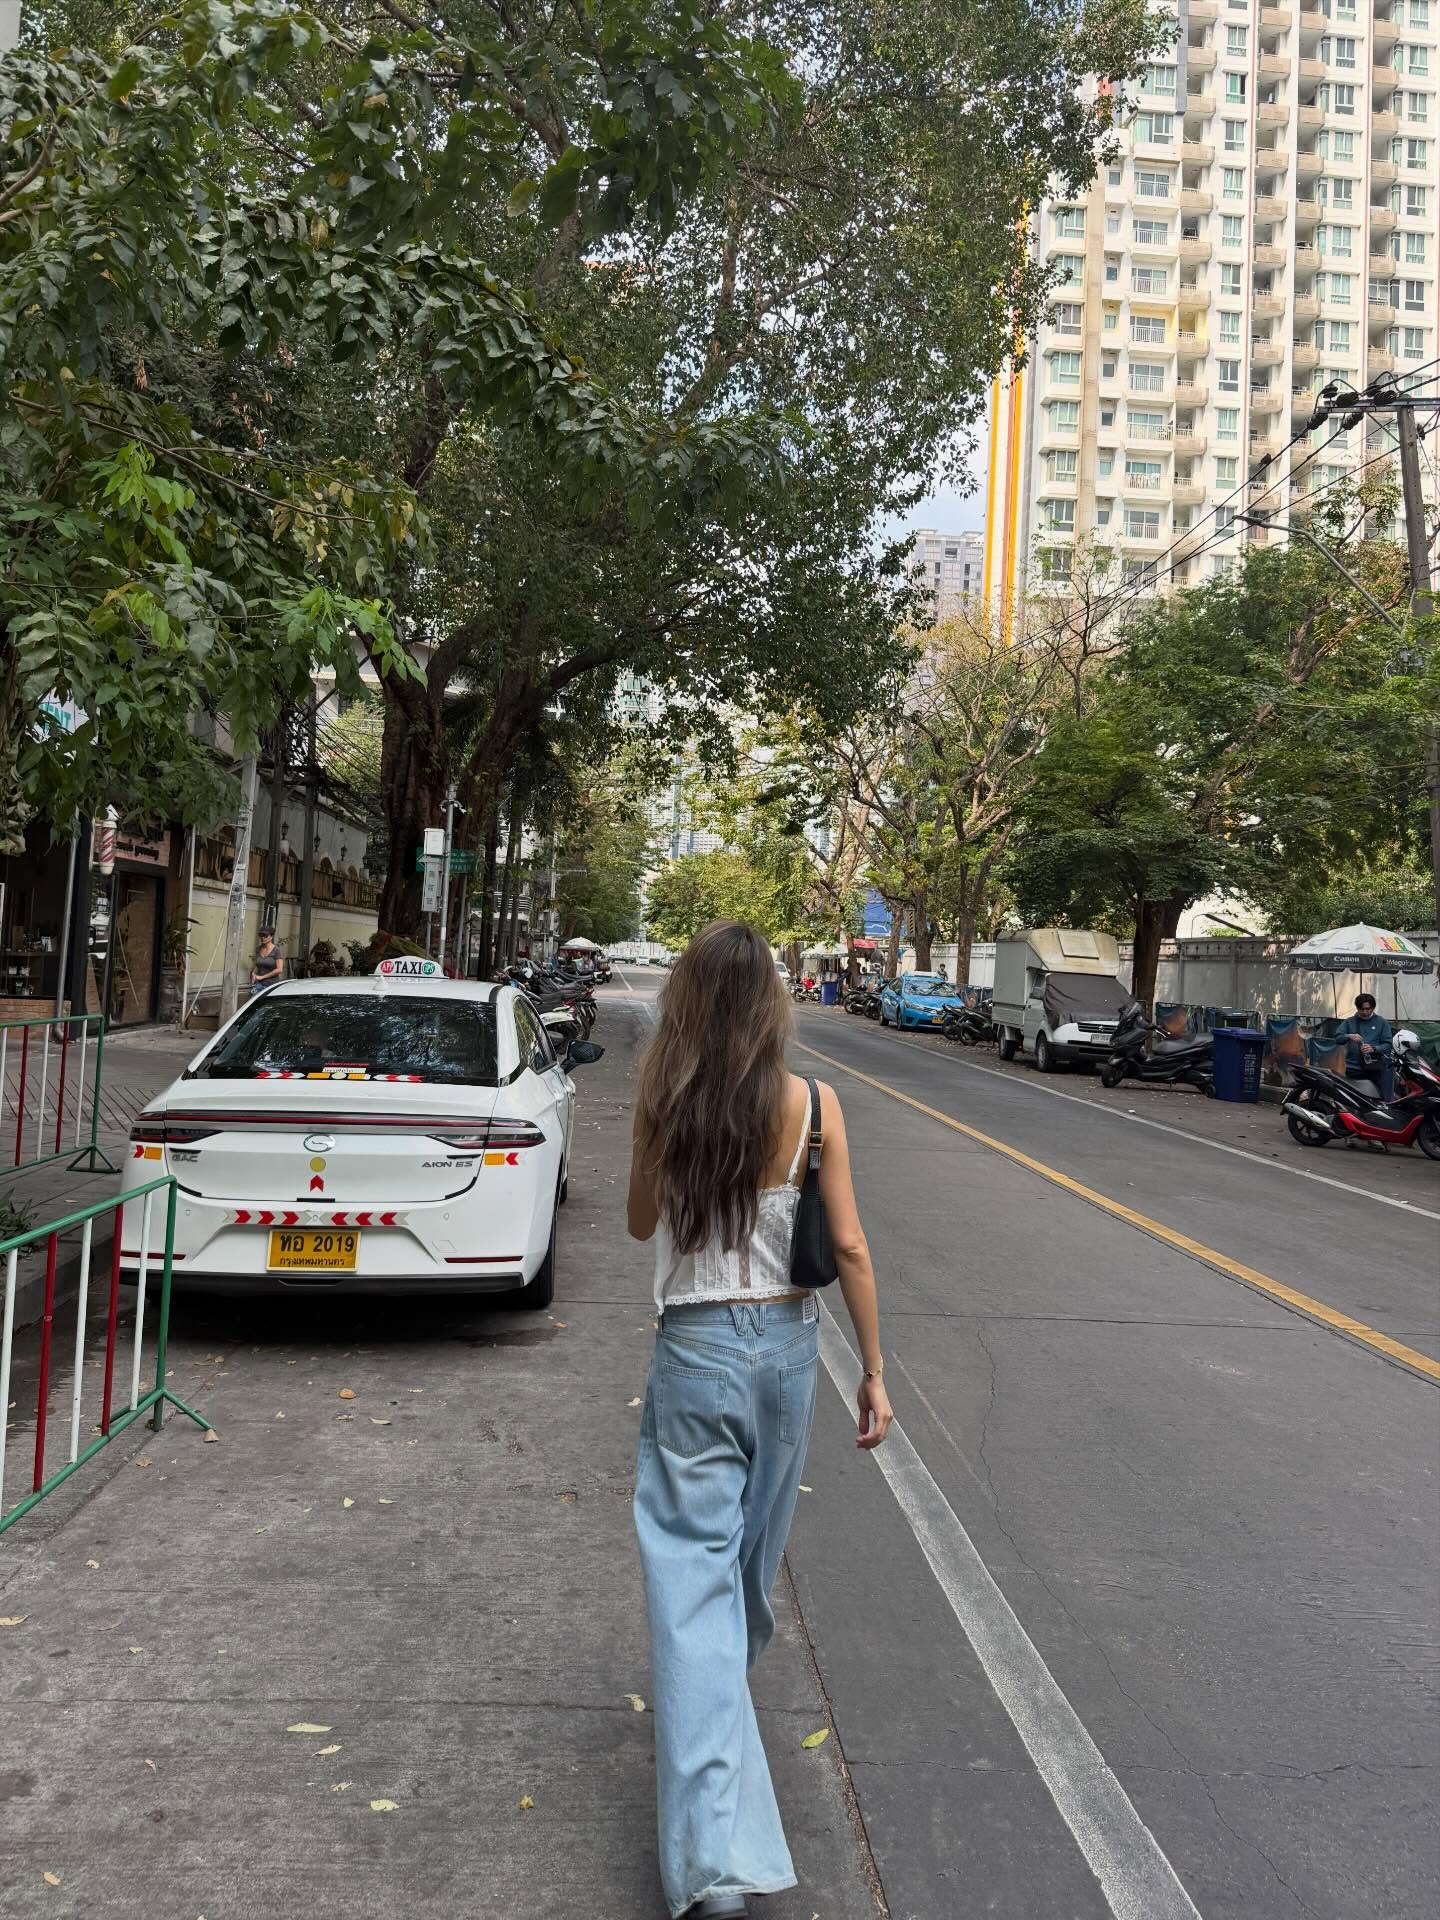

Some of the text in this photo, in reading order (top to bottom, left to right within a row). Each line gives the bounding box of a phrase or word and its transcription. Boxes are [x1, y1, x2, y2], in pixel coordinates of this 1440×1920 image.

[395, 961, 422, 974] TAXI
[423, 963, 434, 974] GPS
[455, 1160, 473, 1168] ES
[313, 1235, 355, 1253] 2019
